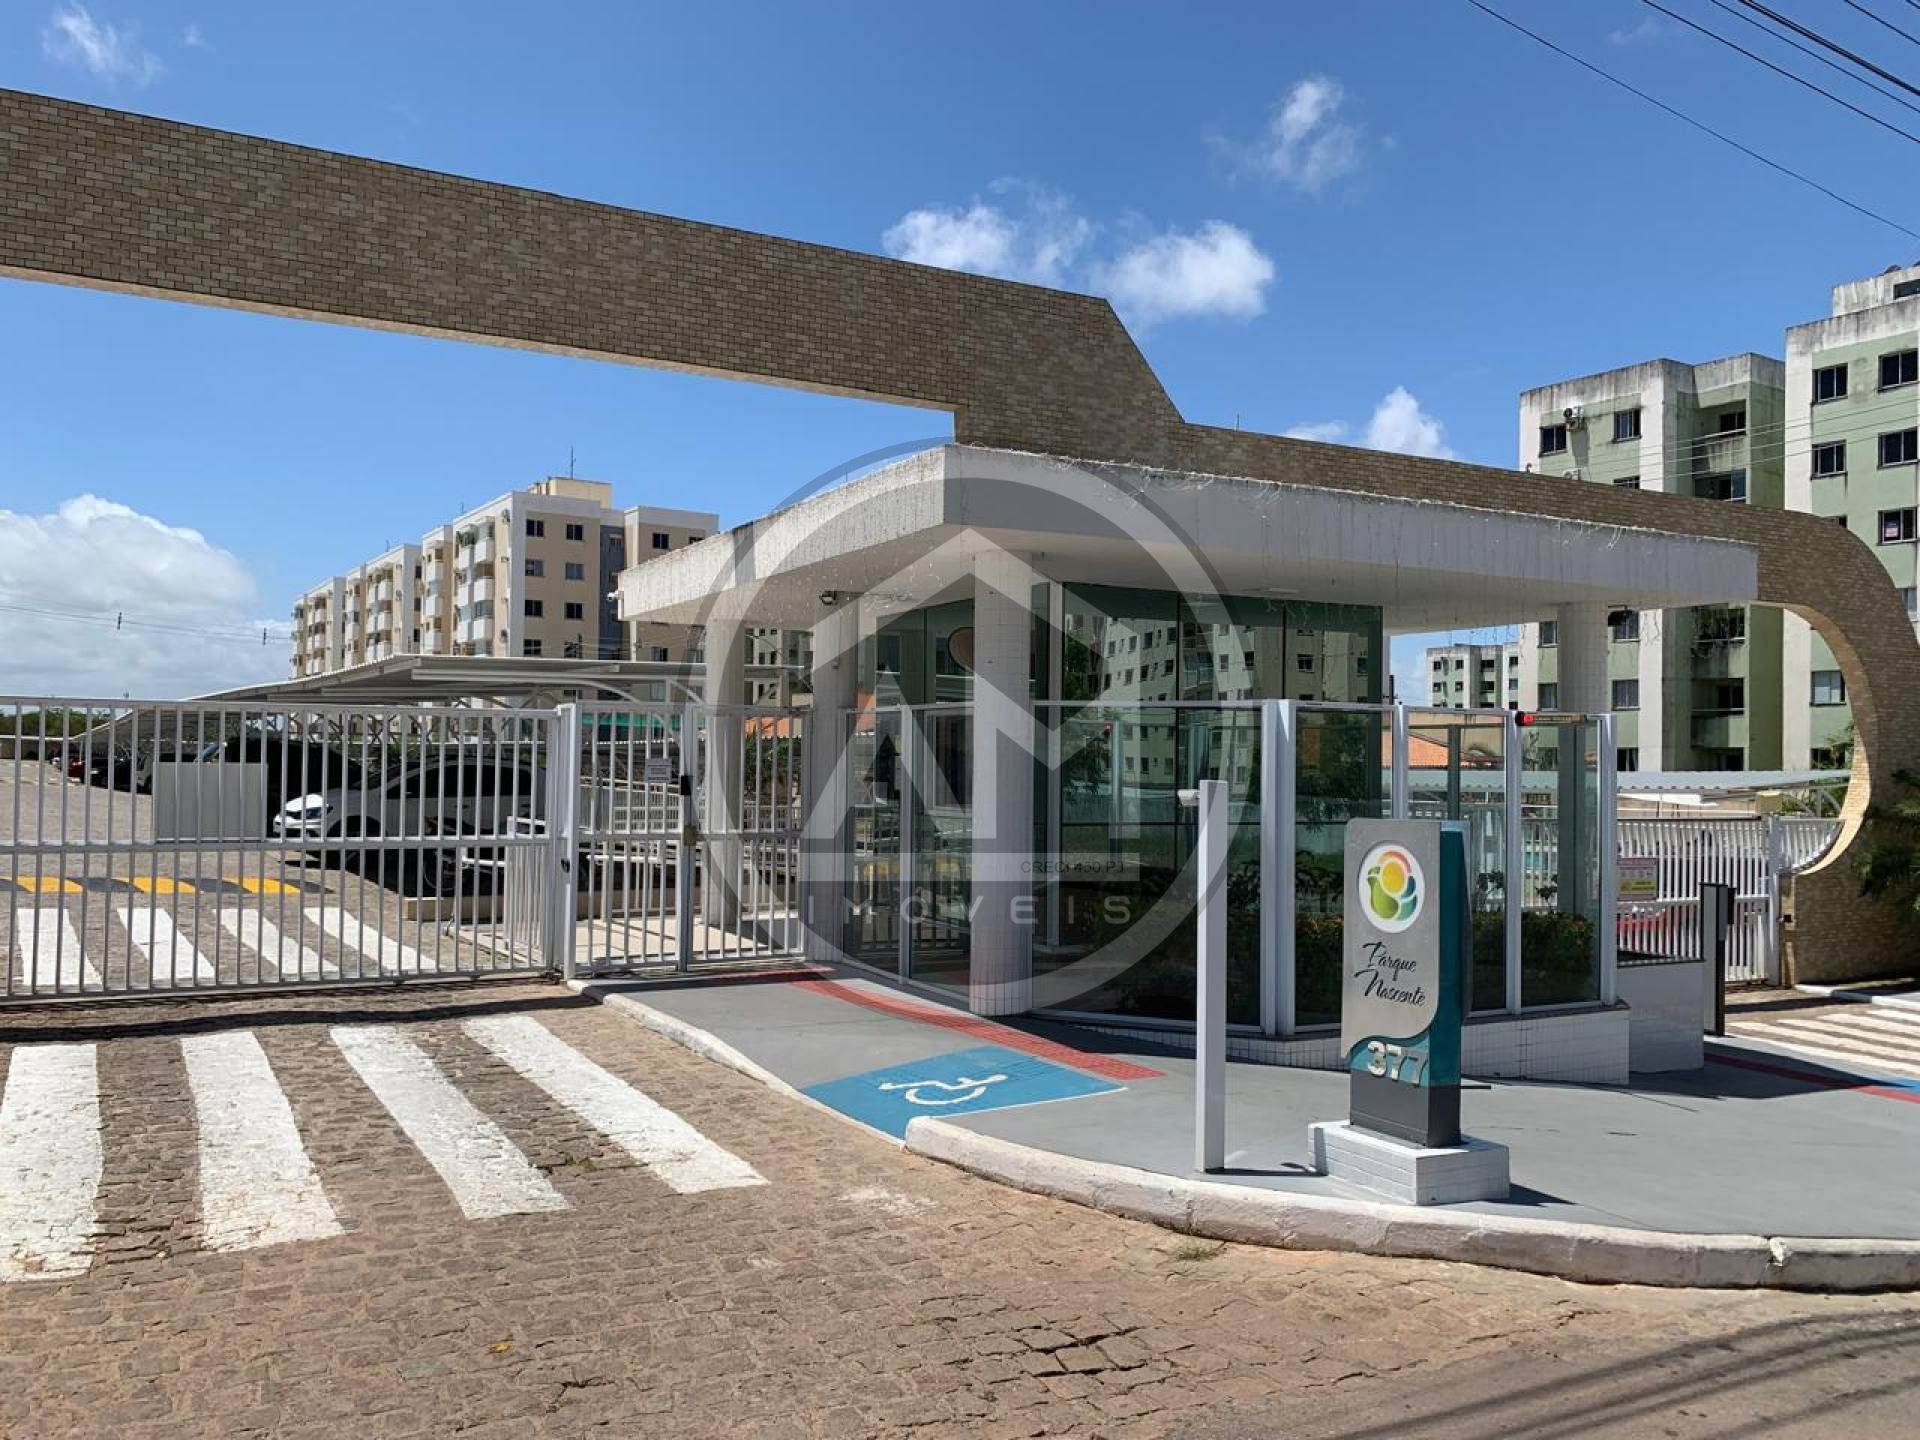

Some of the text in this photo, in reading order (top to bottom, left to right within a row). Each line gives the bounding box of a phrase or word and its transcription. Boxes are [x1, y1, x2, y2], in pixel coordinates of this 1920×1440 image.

[1362, 941, 1417, 981] Parque
[1353, 968, 1426, 1007] Nascente
[1367, 1040, 1428, 1087] 377
